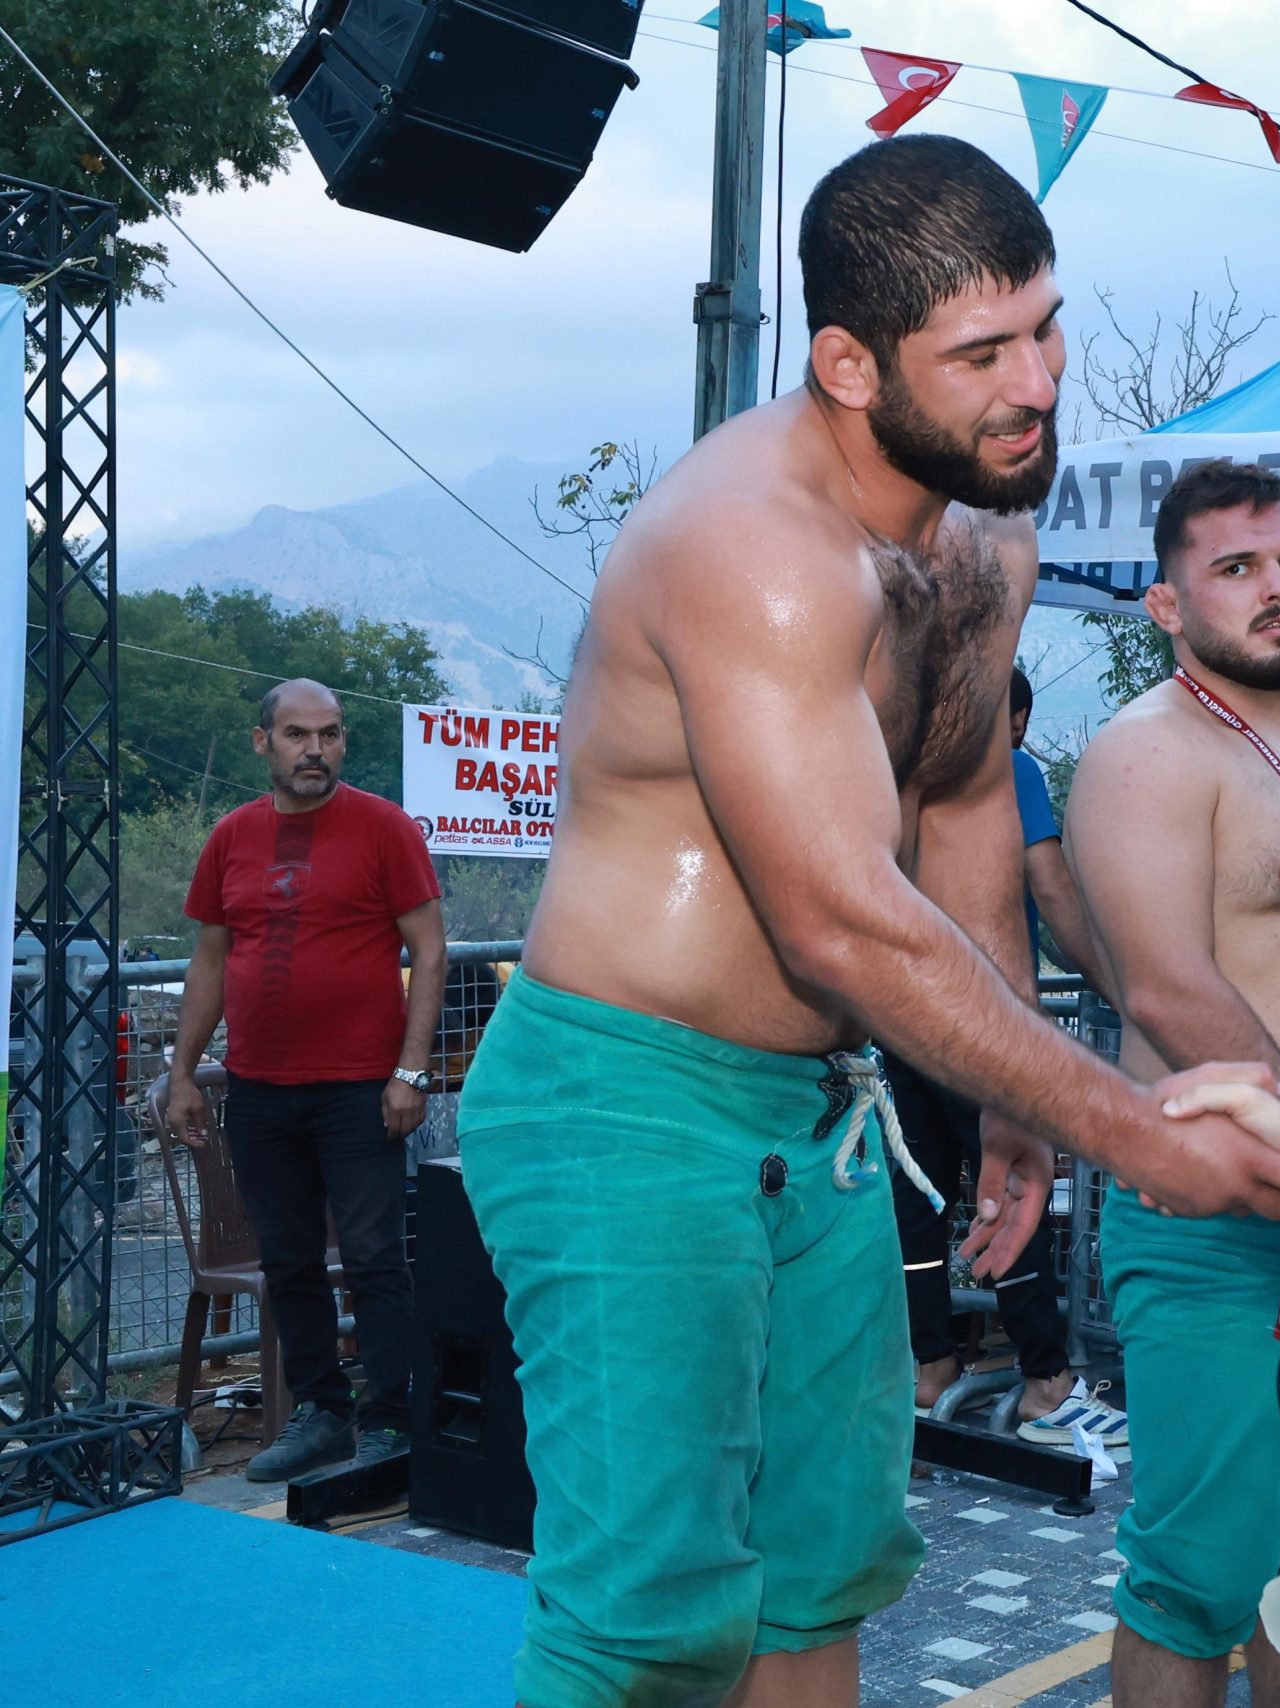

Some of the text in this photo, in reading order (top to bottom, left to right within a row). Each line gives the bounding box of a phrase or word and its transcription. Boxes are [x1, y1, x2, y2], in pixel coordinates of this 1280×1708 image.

[418, 709, 490, 749] TÜM
[437, 816, 522, 836] BALCILAR
[434, 832, 468, 844] petlas
[479, 837, 512, 846] LASSA
